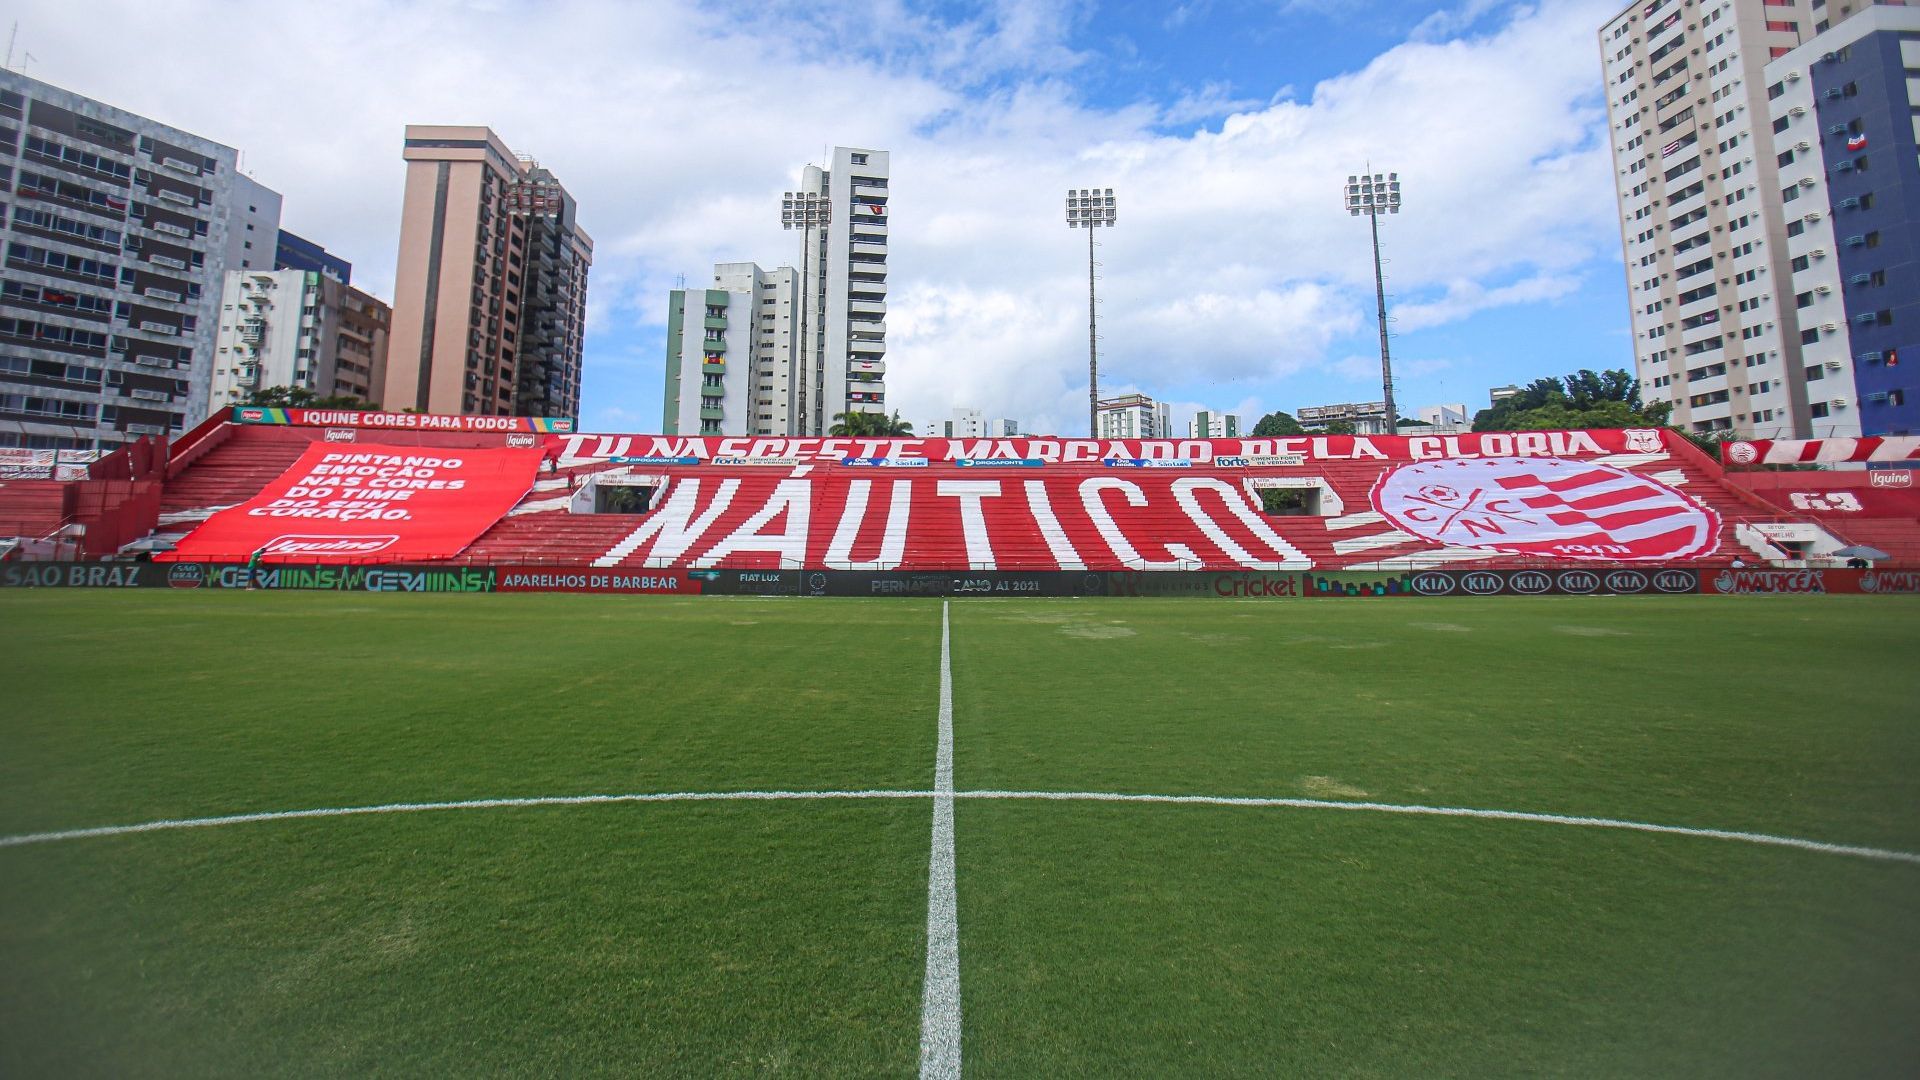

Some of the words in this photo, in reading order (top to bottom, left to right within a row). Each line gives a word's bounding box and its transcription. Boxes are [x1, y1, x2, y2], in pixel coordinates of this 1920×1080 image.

[303, 411, 359, 424] IQUINE
[363, 412, 416, 426] CORES
[420, 415, 461, 428] PARA
[465, 417, 518, 429] TODOS
[326, 430, 354, 441] Iquine
[508, 435, 533, 446] Iquine
[558, 435, 631, 459] TU
[644, 436, 925, 460] NASCESTE
[944, 438, 1213, 463] MARCADO
[322, 453, 463, 469] PINTANDO
[714, 456, 747, 465] forte
[1216, 457, 1250, 467] forte
[311, 464, 436, 479] EMOÇÃO
[298, 476, 363, 487] NAS
[368, 478, 465, 490] CORES
[1873, 474, 1909, 486] Iquine
[284, 486, 334, 498] DO
[340, 488, 415, 500] TIME
[266, 499, 320, 508] DO
[322, 500, 391, 509] SEU
[592, 464, 1316, 571] NÁUTICO
[1403, 507, 1437, 522] C
[1460, 517, 1506, 537] N
[1485, 500, 1521, 514] C
[267, 539, 386, 553] Iquine
[68, 565, 141, 587] BRAZ
[503, 575, 586, 587] APARELHOS
[590, 575, 609, 588] DE
[612, 576, 677, 589] BARBEAR
[739, 573, 760, 582] FIAT
[760, 573, 780, 582] LUX
[1613, 576, 1641, 588] KIA
[1661, 575, 1689, 587] KIA
[1012, 580, 1040, 591] 2021
[1214, 574, 1298, 597] Cricket
[1419, 578, 1448, 590] KIA
[1468, 578, 1497, 590] KIA
[1517, 577, 1546, 589] KIA
[1565, 577, 1594, 588] KIA
